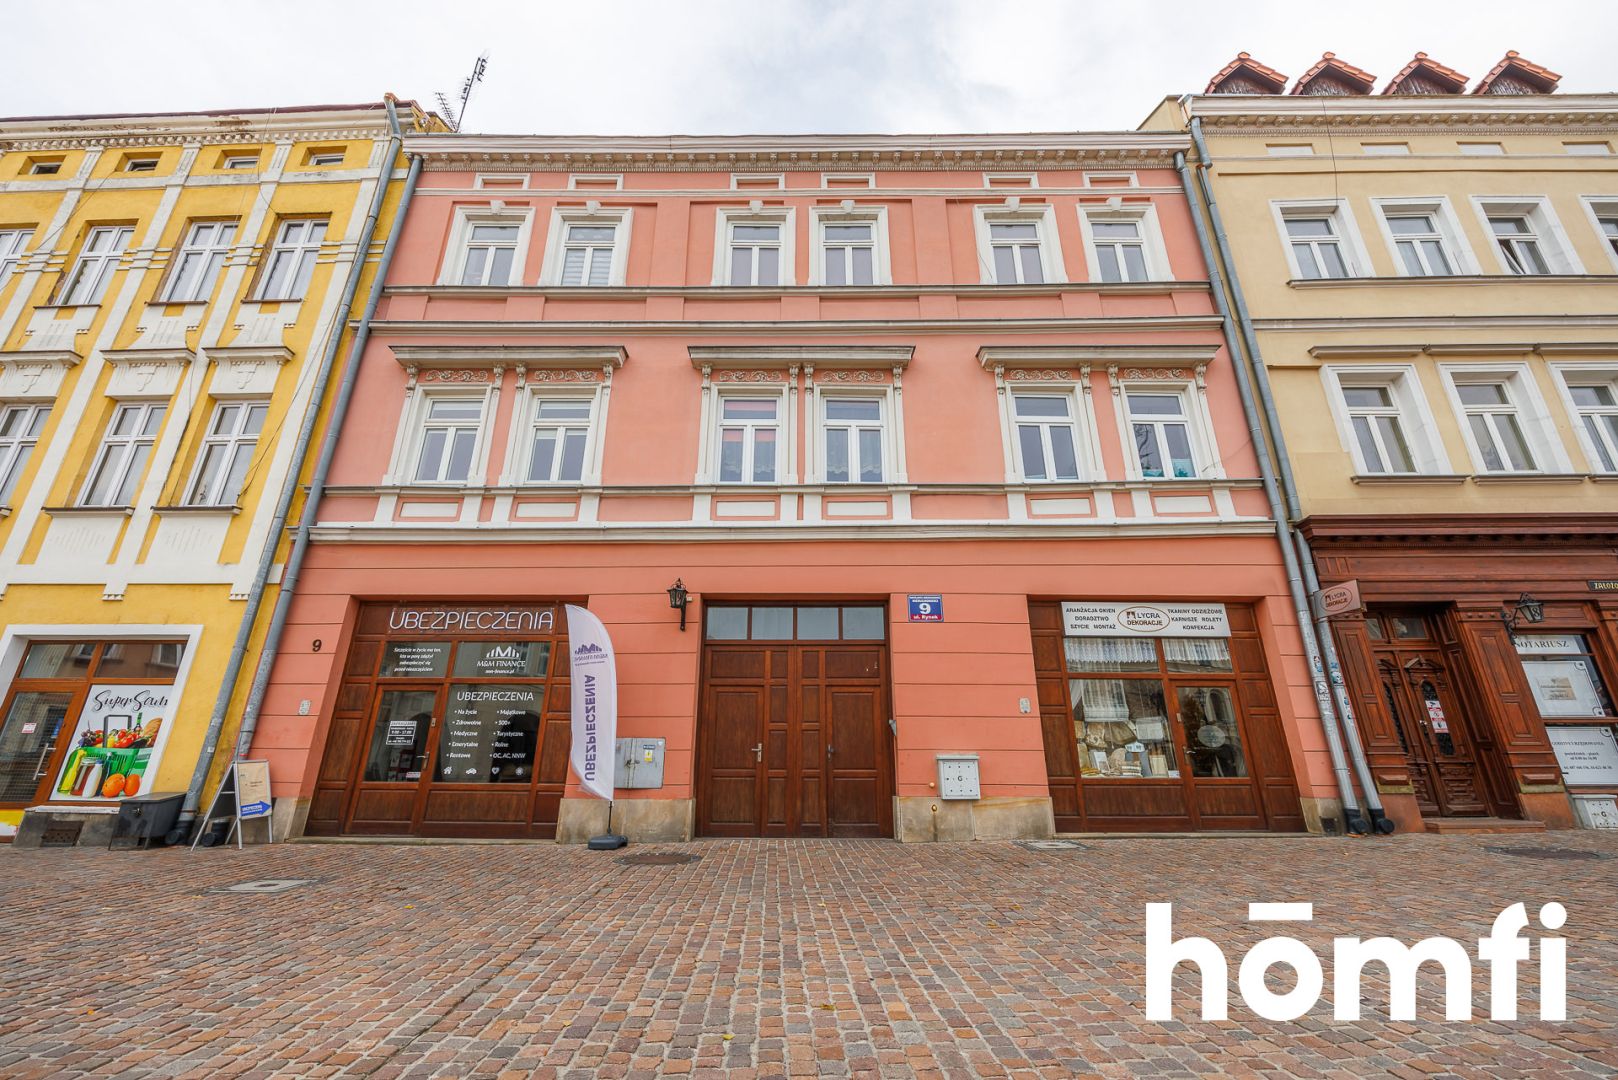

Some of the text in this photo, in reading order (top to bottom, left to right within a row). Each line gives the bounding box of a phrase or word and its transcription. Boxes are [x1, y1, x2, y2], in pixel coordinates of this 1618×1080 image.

[919, 603, 931, 614] 9
[1532, 608, 1540, 617] 8
[389, 611, 554, 630] UBEZPIECZENIA
[312, 639, 322, 652] 9
[457, 692, 534, 700] UBEZPIECZENIA
